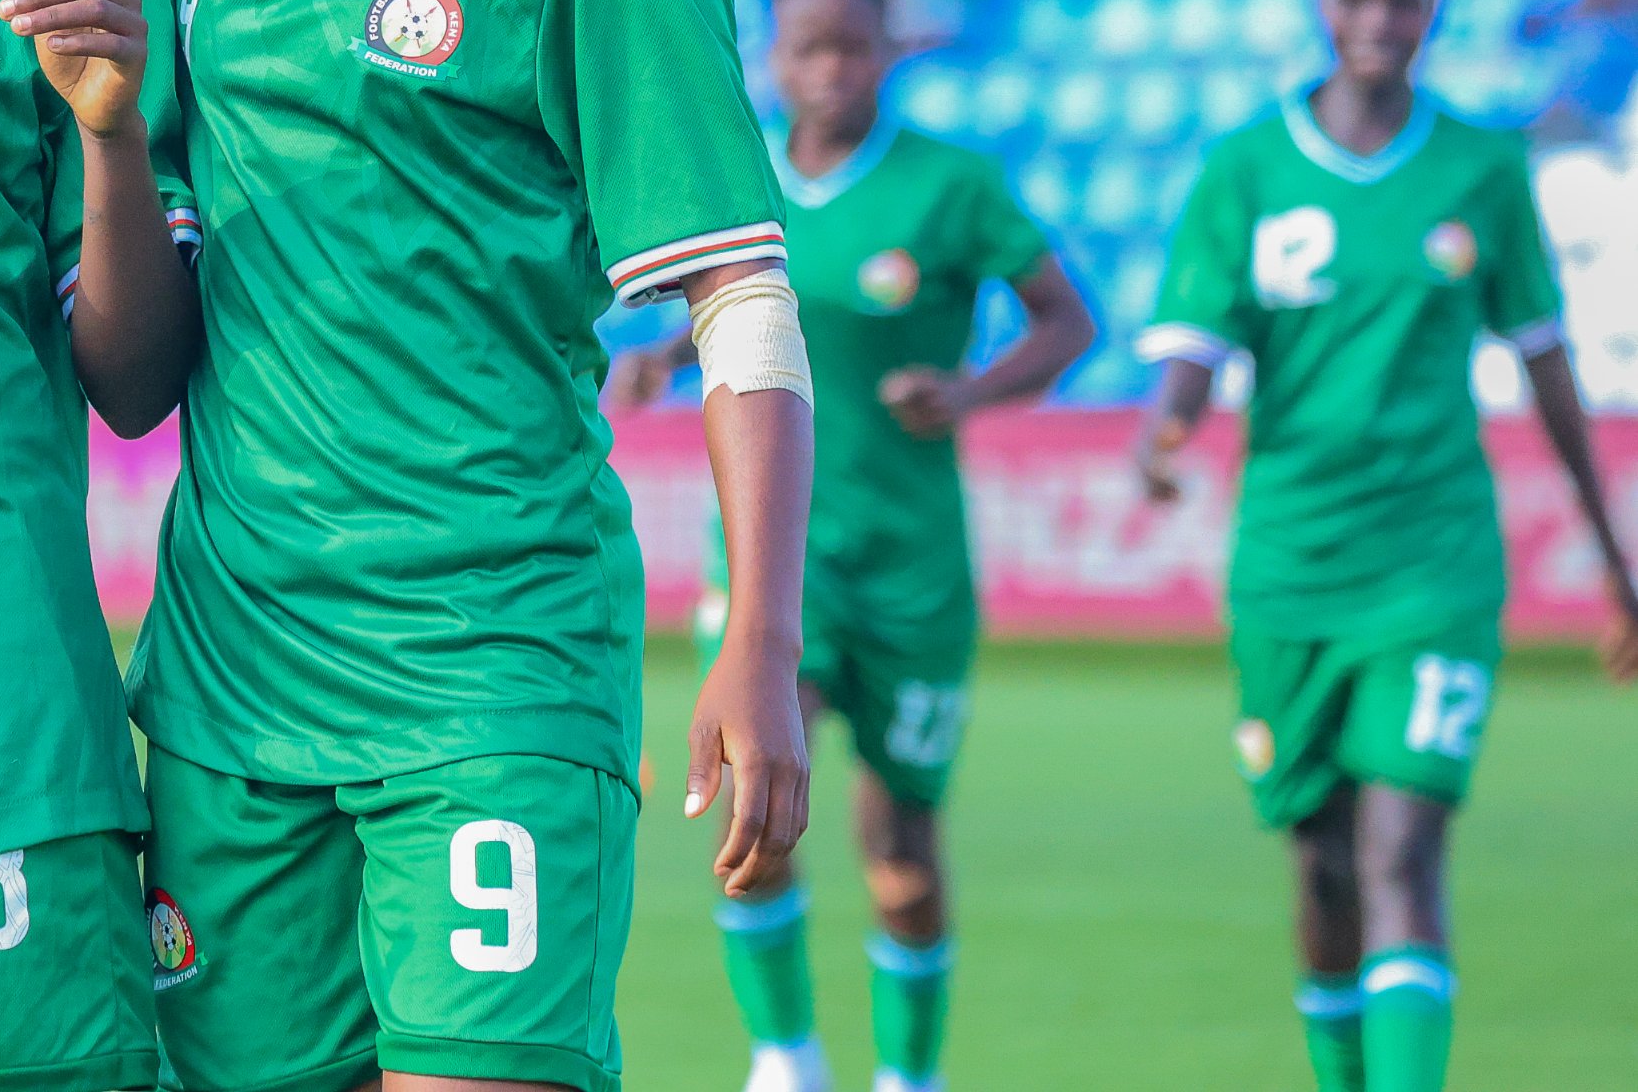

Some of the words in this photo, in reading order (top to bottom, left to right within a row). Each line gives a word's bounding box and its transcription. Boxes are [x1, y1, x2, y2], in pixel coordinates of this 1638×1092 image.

[364, 51, 437, 77] FEDERATION
[440, 11, 459, 52] KENYA
[1407, 654, 1486, 758] 12
[450, 820, 537, 972] 9
